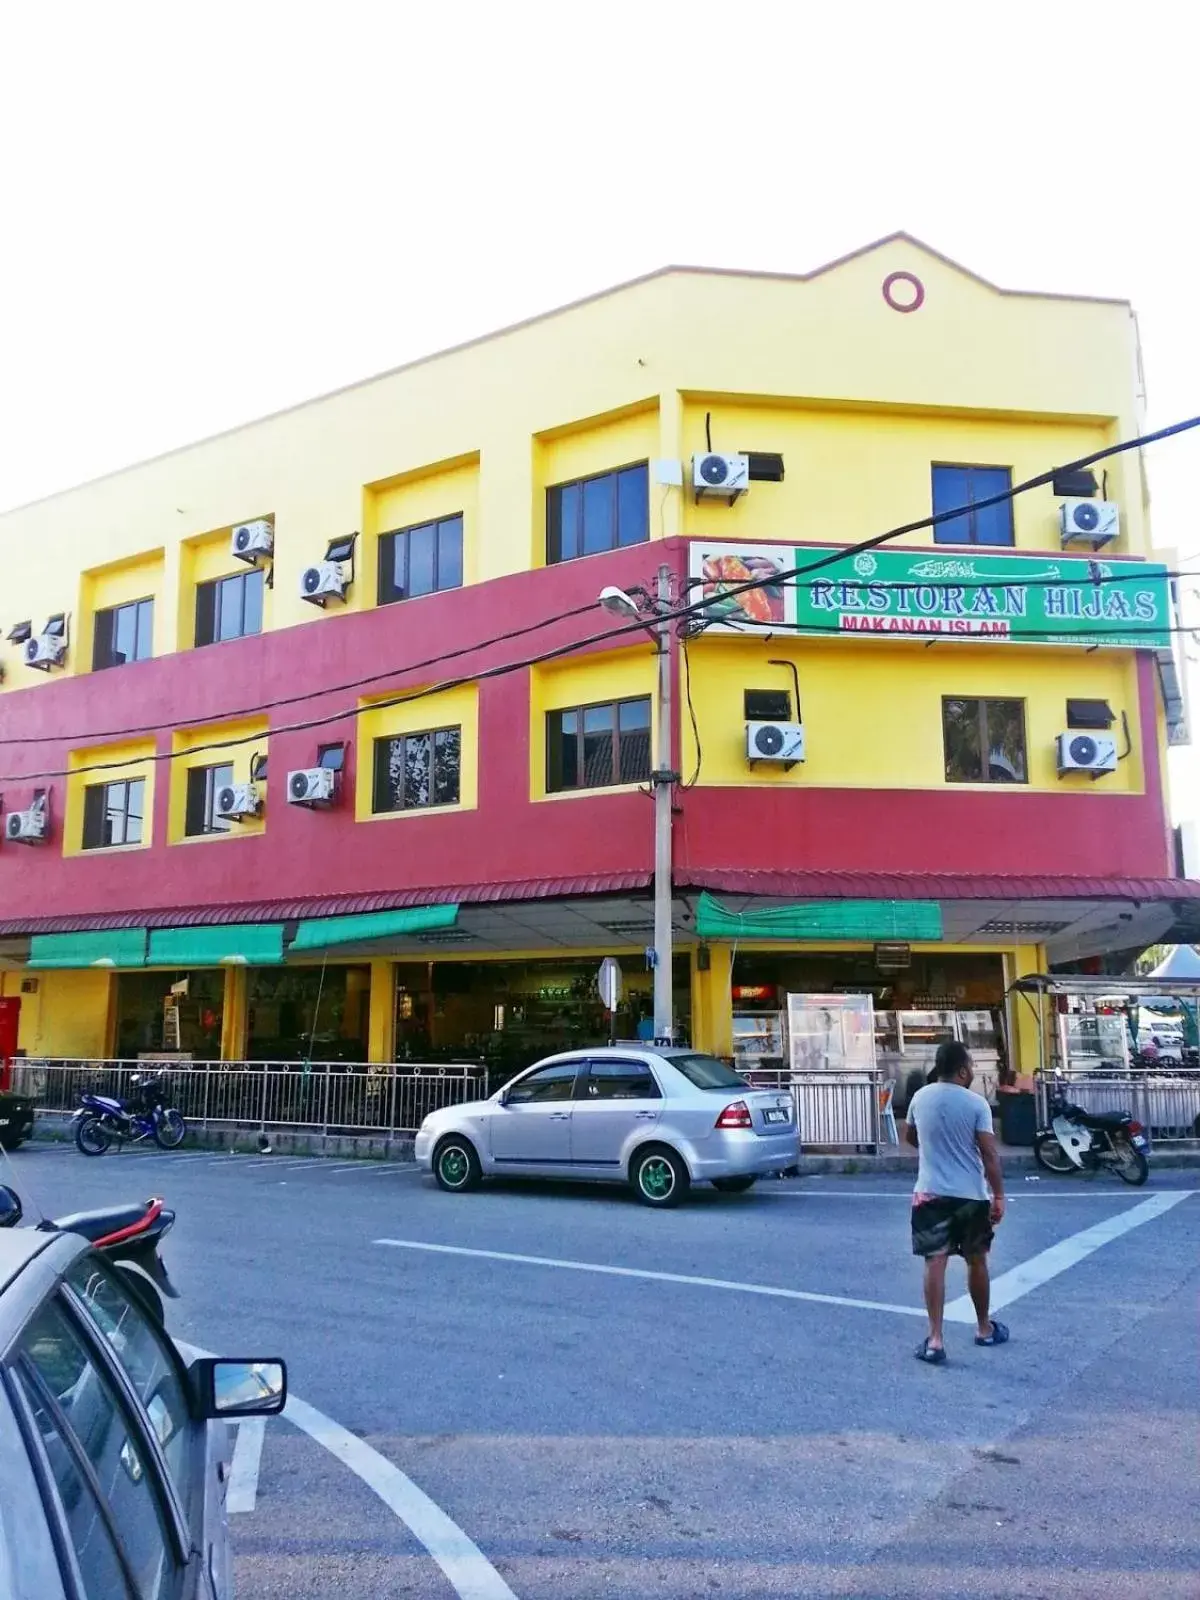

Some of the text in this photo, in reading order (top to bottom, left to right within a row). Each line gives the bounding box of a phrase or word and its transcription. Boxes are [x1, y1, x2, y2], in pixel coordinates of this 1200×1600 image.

[810, 578, 1157, 619] RESTORAN HIJAS
[842, 615, 1009, 637] MAKANAN ISLAM
